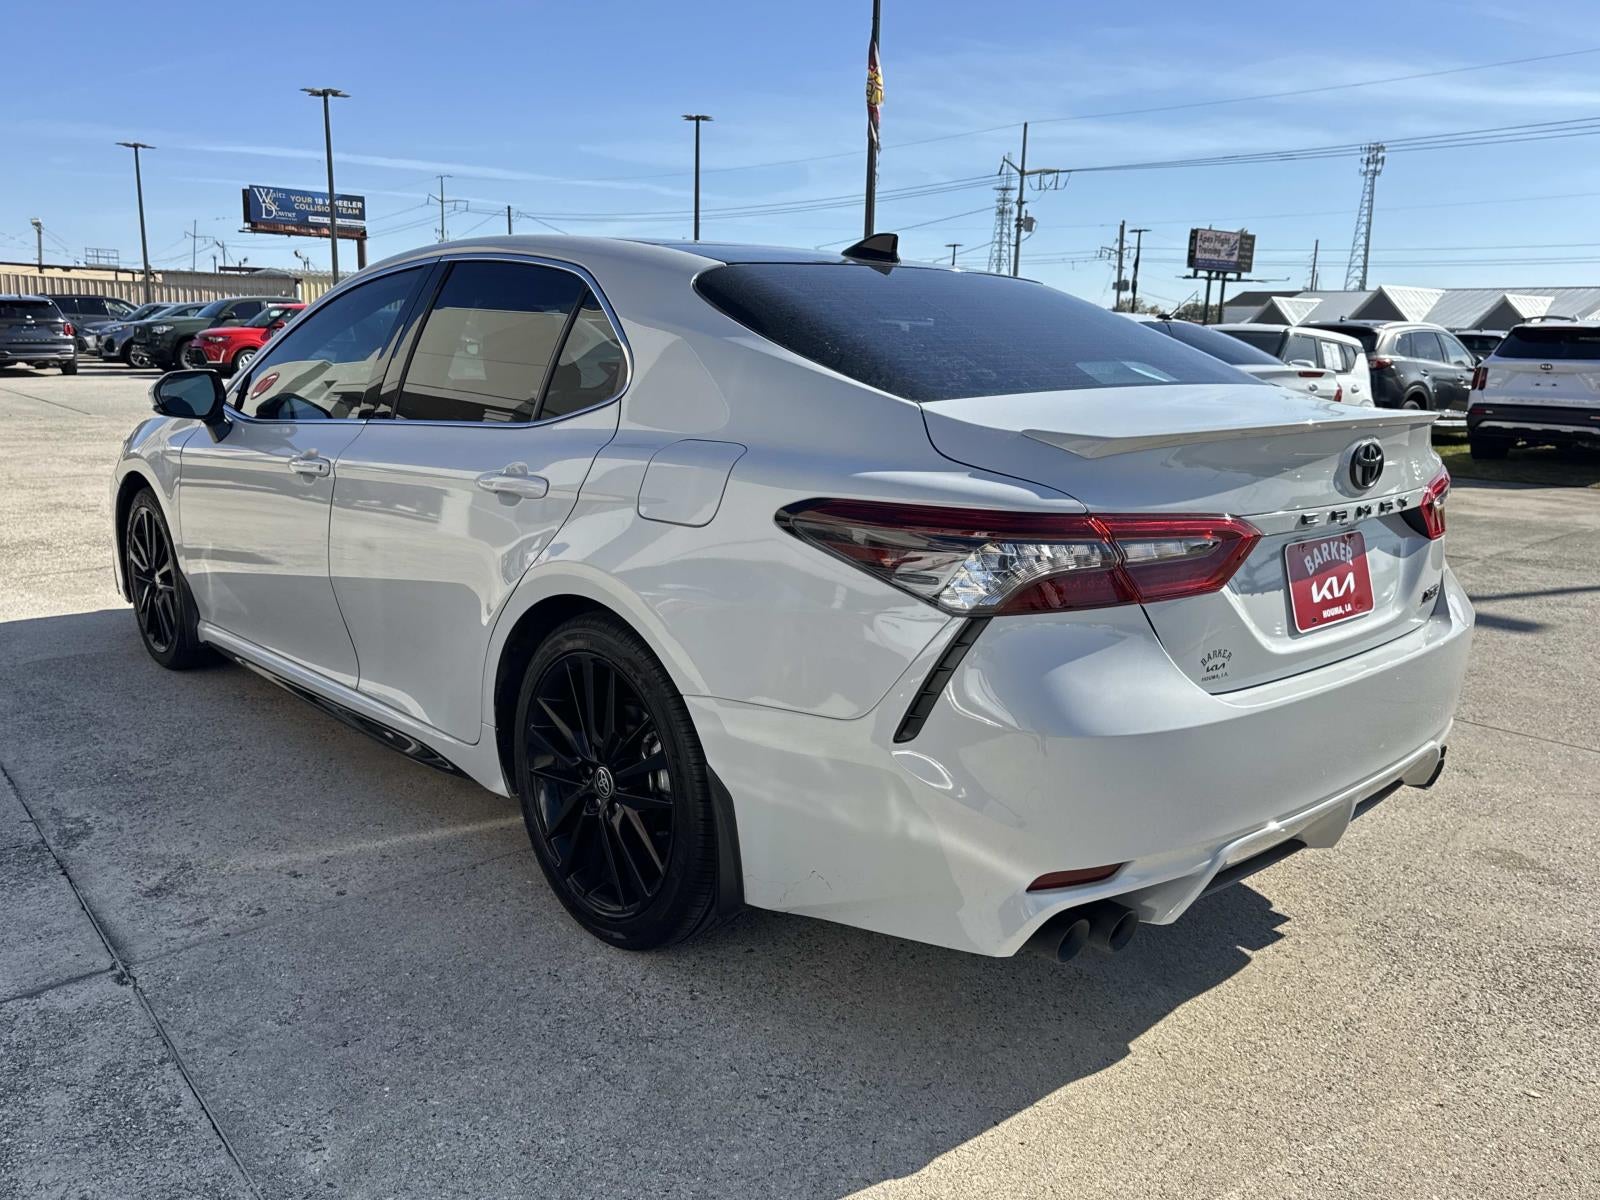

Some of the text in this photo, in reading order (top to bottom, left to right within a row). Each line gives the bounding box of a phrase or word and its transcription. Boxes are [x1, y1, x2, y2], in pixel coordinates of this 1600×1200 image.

[290, 195, 313, 204] YOUR
[294, 203, 360, 215] COLLISIO TEAM
[1304, 541, 1354, 576] BARKER
[1311, 571, 1356, 603] KIA
[1322, 603, 1353, 618] HOUMA, LA
[1200, 649, 1232, 666] BARKER
